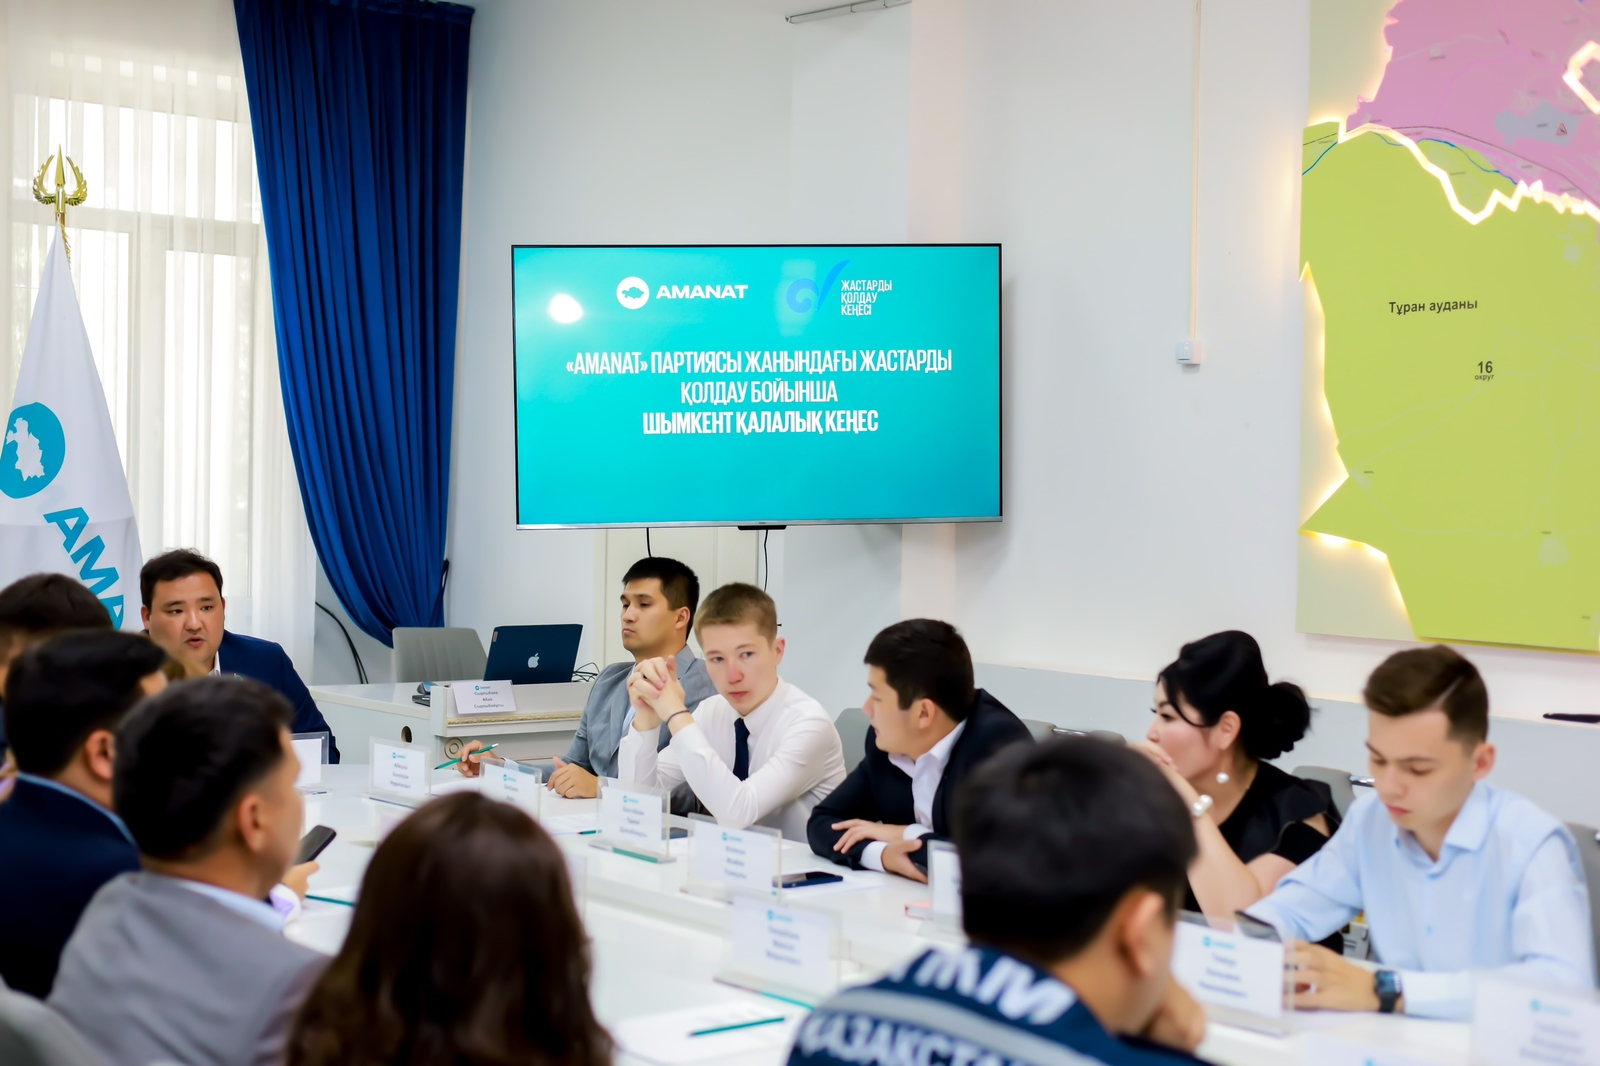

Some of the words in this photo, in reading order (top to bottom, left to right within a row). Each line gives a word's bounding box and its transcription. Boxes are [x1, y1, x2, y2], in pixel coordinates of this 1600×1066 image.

[656, 284, 749, 299] AMANAT
[841, 279, 893, 292] ЖАСТАРДЫ
[841, 292, 878, 305] ҚОЛДАУ
[841, 303, 872, 317] КЕҢЕСІ
[1388, 301, 1426, 316] Тұран
[1429, 300, 1478, 314] ауданы
[566, 351, 648, 375] «AMANAT»
[651, 350, 742, 374] ПАРТИЯСЫ
[744, 350, 857, 375] ЖАНЫНДАҒЫ
[859, 349, 952, 374] ЖАСТАРДЫ
[1477, 360, 1494, 374] 16
[1474, 373, 1495, 382] округ
[680, 381, 748, 406] ҚОЛДАУ
[751, 377, 839, 404] БОЙЫНША
[642, 410, 734, 435] ШЫМКЕНТ
[735, 410, 824, 436] ҚАЛАЛЫҚ
[825, 409, 879, 434] КЕҢЕС
